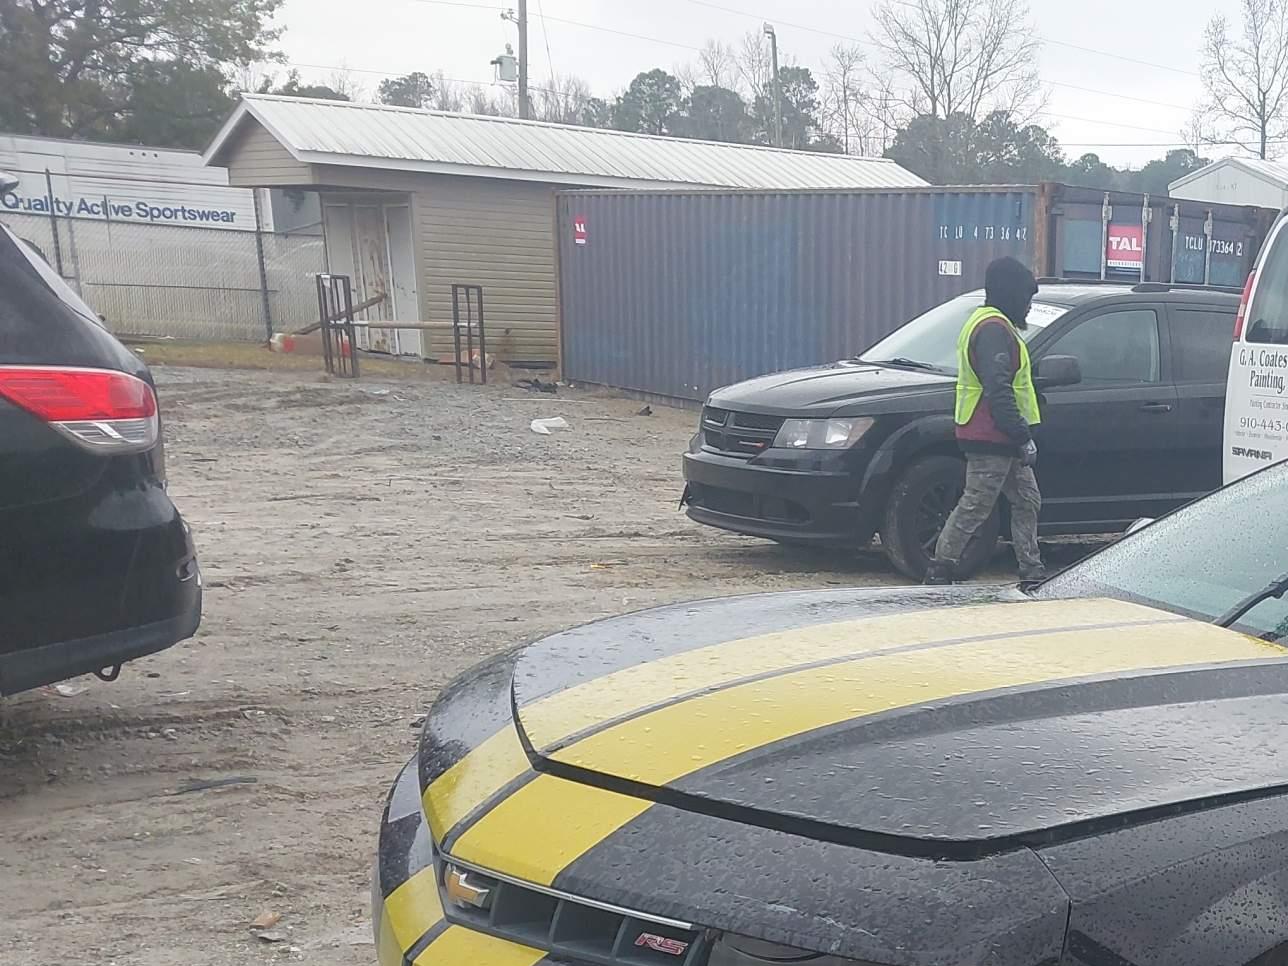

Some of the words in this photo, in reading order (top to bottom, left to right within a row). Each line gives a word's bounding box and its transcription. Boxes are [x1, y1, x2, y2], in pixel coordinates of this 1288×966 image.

[3, 192, 73, 216] Qualty
[77, 198, 132, 217] Active
[136, 202, 236, 223] Sportswear
[1109, 236, 1142, 251] TAL
[1185, 236, 1204, 250] TCLU
[1239, 349, 1247, 366] G.
[1248, 351, 1256, 367] A.
[1259, 350, 1288, 369] Coates
[1250, 366, 1286, 394] Painting,
[1232, 446, 1273, 460] SAVANA
[634, 931, 688, 955] RS
